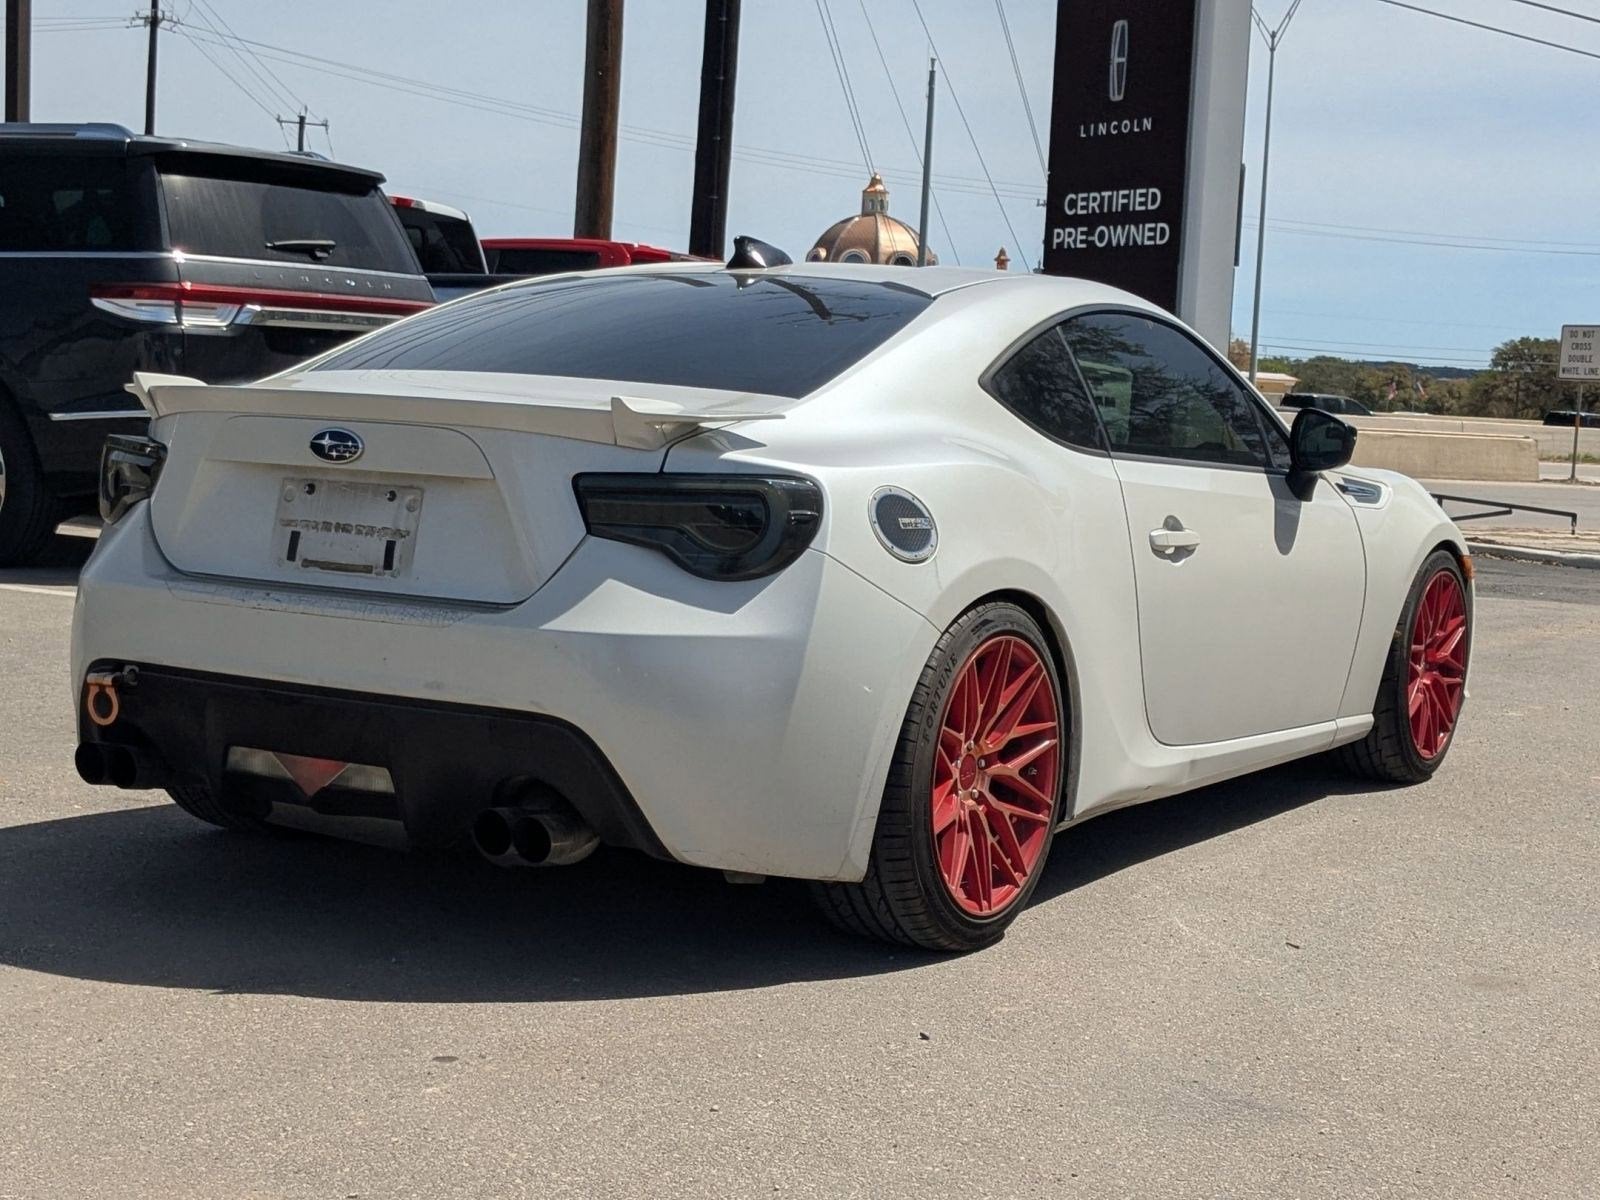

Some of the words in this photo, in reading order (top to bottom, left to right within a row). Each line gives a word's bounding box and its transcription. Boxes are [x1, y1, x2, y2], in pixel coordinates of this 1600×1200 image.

[1080, 118, 1152, 137] LINCOLN
[1064, 188, 1161, 215] CERTIFIED
[1052, 222, 1170, 249] PRE-OWNED
[1570, 330, 1579, 338] DO
[1583, 330, 1595, 338] NOT
[1571, 342, 1592, 351] CROSS
[1568, 354, 1593, 363] DOUBLE
[1562, 367, 1580, 375] WHITE
[1584, 368, 1600, 376] LINE
[922, 653, 958, 744] FORTUNE
